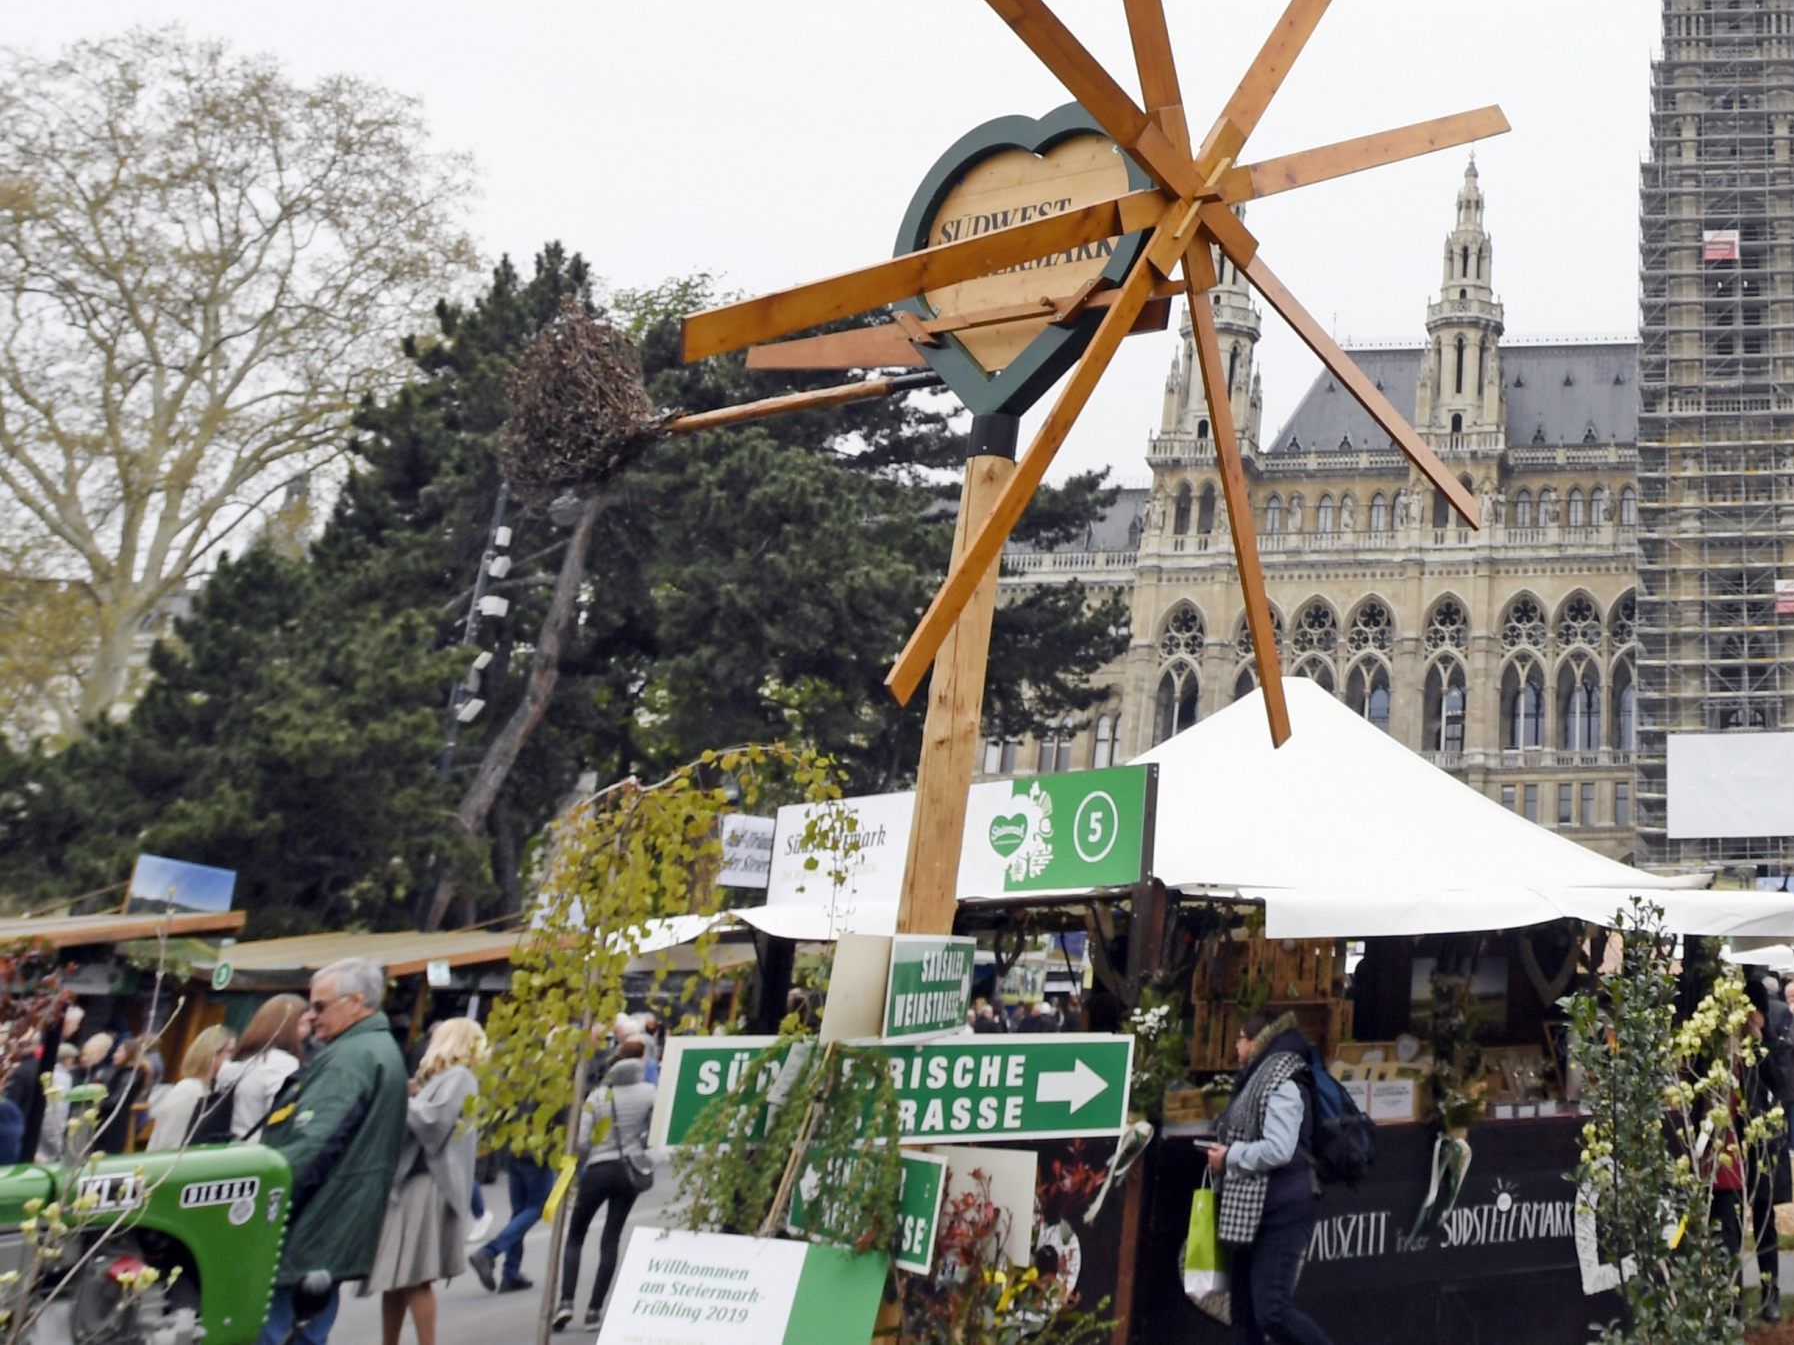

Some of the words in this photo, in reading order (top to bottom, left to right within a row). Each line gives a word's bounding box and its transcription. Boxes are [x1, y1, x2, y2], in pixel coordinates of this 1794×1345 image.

[1087, 810, 1103, 843] 5
[1306, 1211, 1390, 1261] AUSZEIT
[646, 1258, 750, 1281] Willkommen
[639, 1281, 665, 1295] am
[671, 1281, 765, 1304] Steiermark-
[631, 1299, 703, 1324] Frühling
[705, 1306, 749, 1324] 2019
